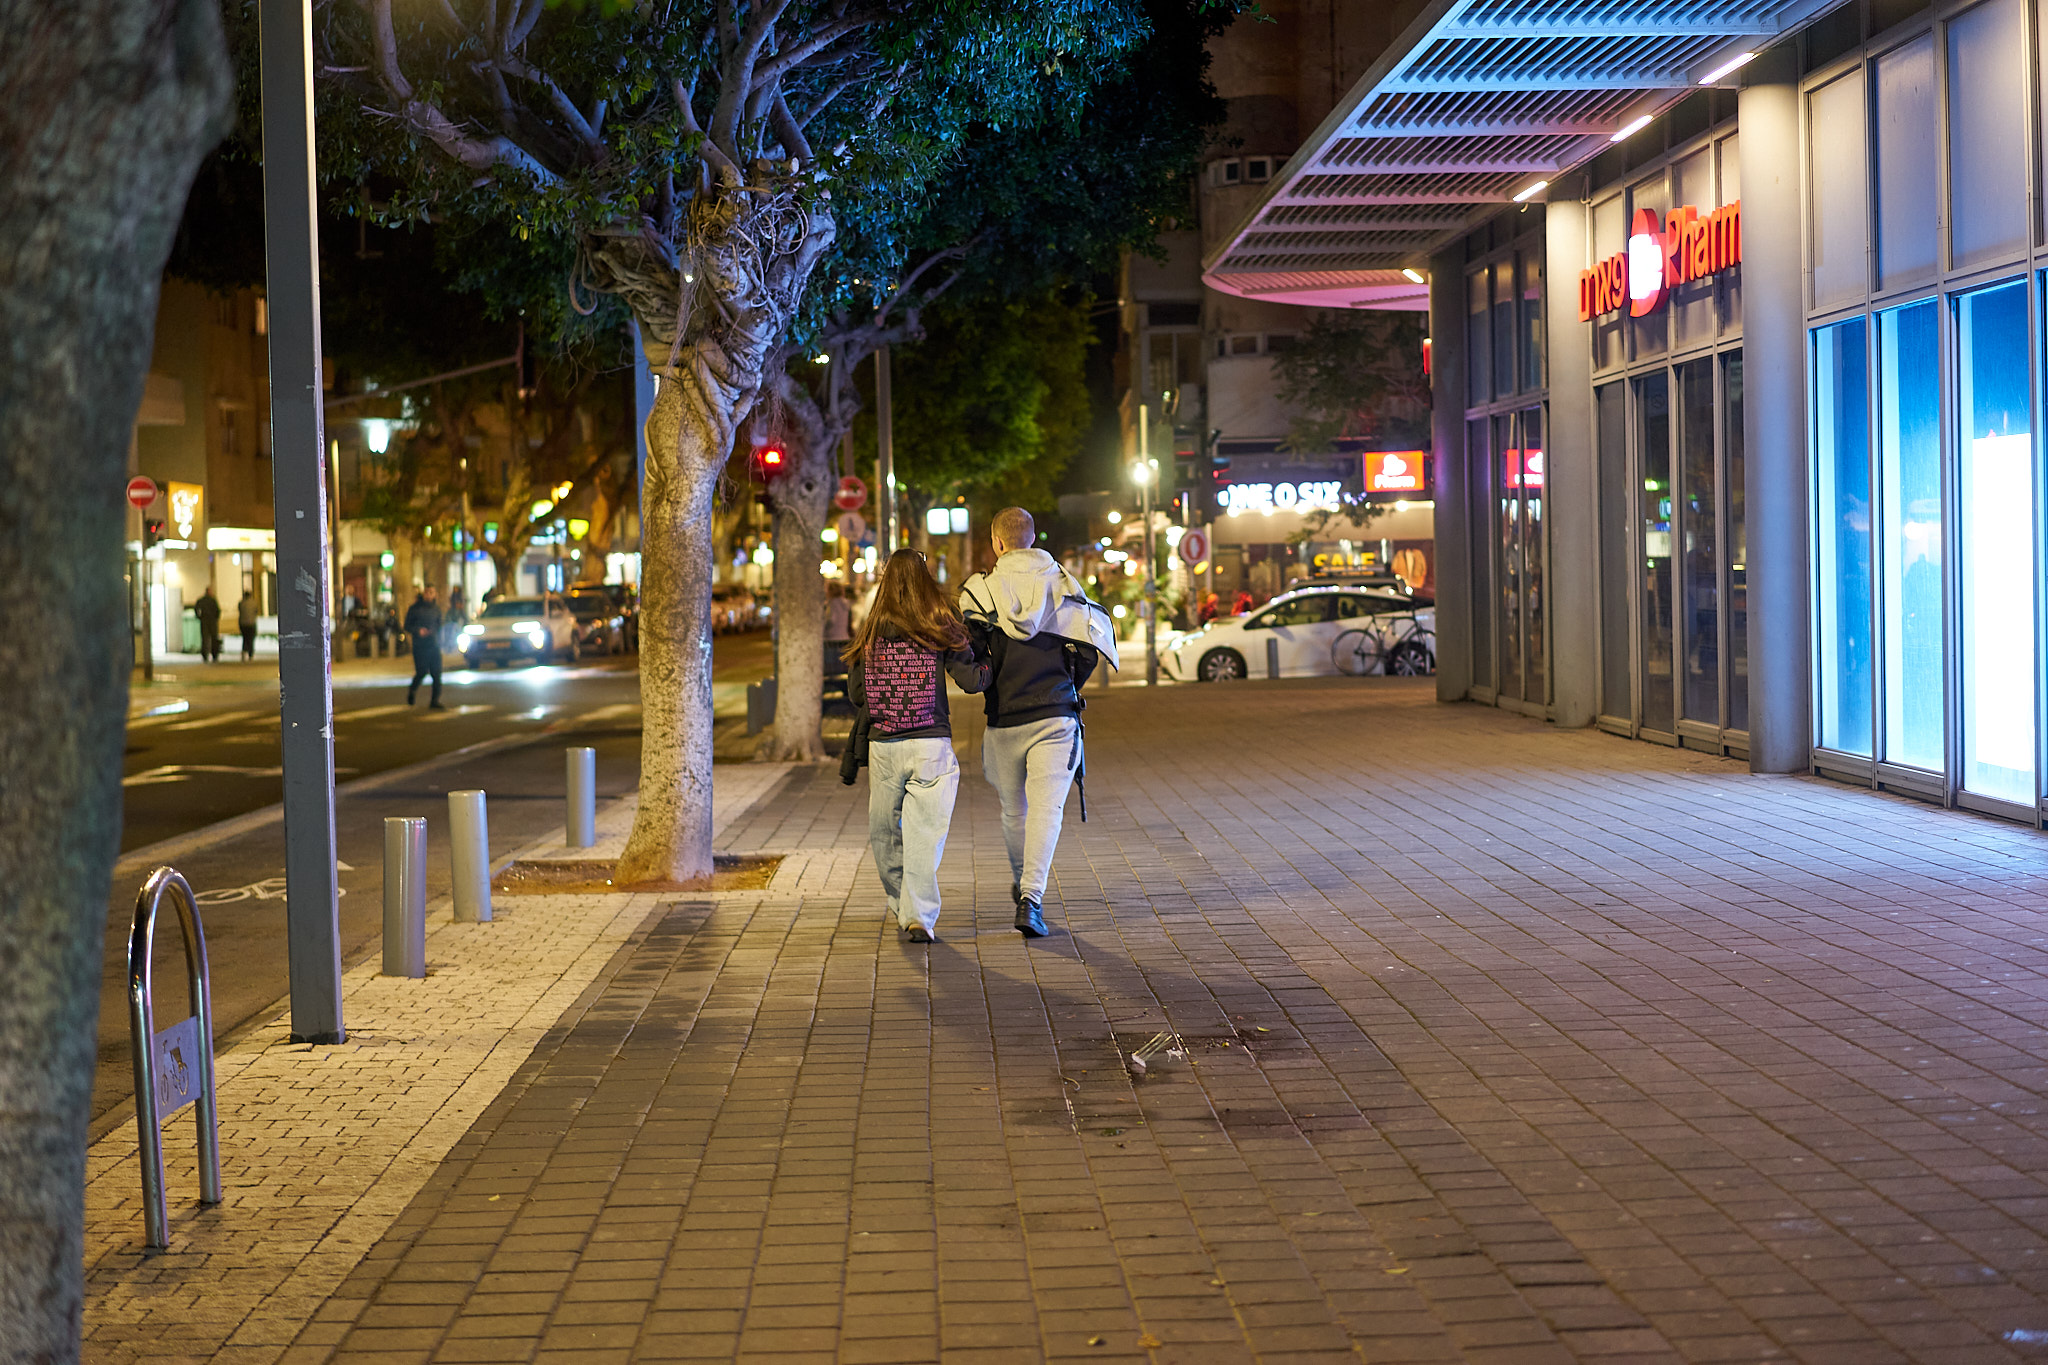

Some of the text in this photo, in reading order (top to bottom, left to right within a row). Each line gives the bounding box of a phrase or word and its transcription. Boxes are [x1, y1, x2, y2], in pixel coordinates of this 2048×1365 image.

[1664, 199, 1742, 290] Pharm
[1578, 252, 1628, 323] פארם
[1298, 481, 1343, 508] SIX
